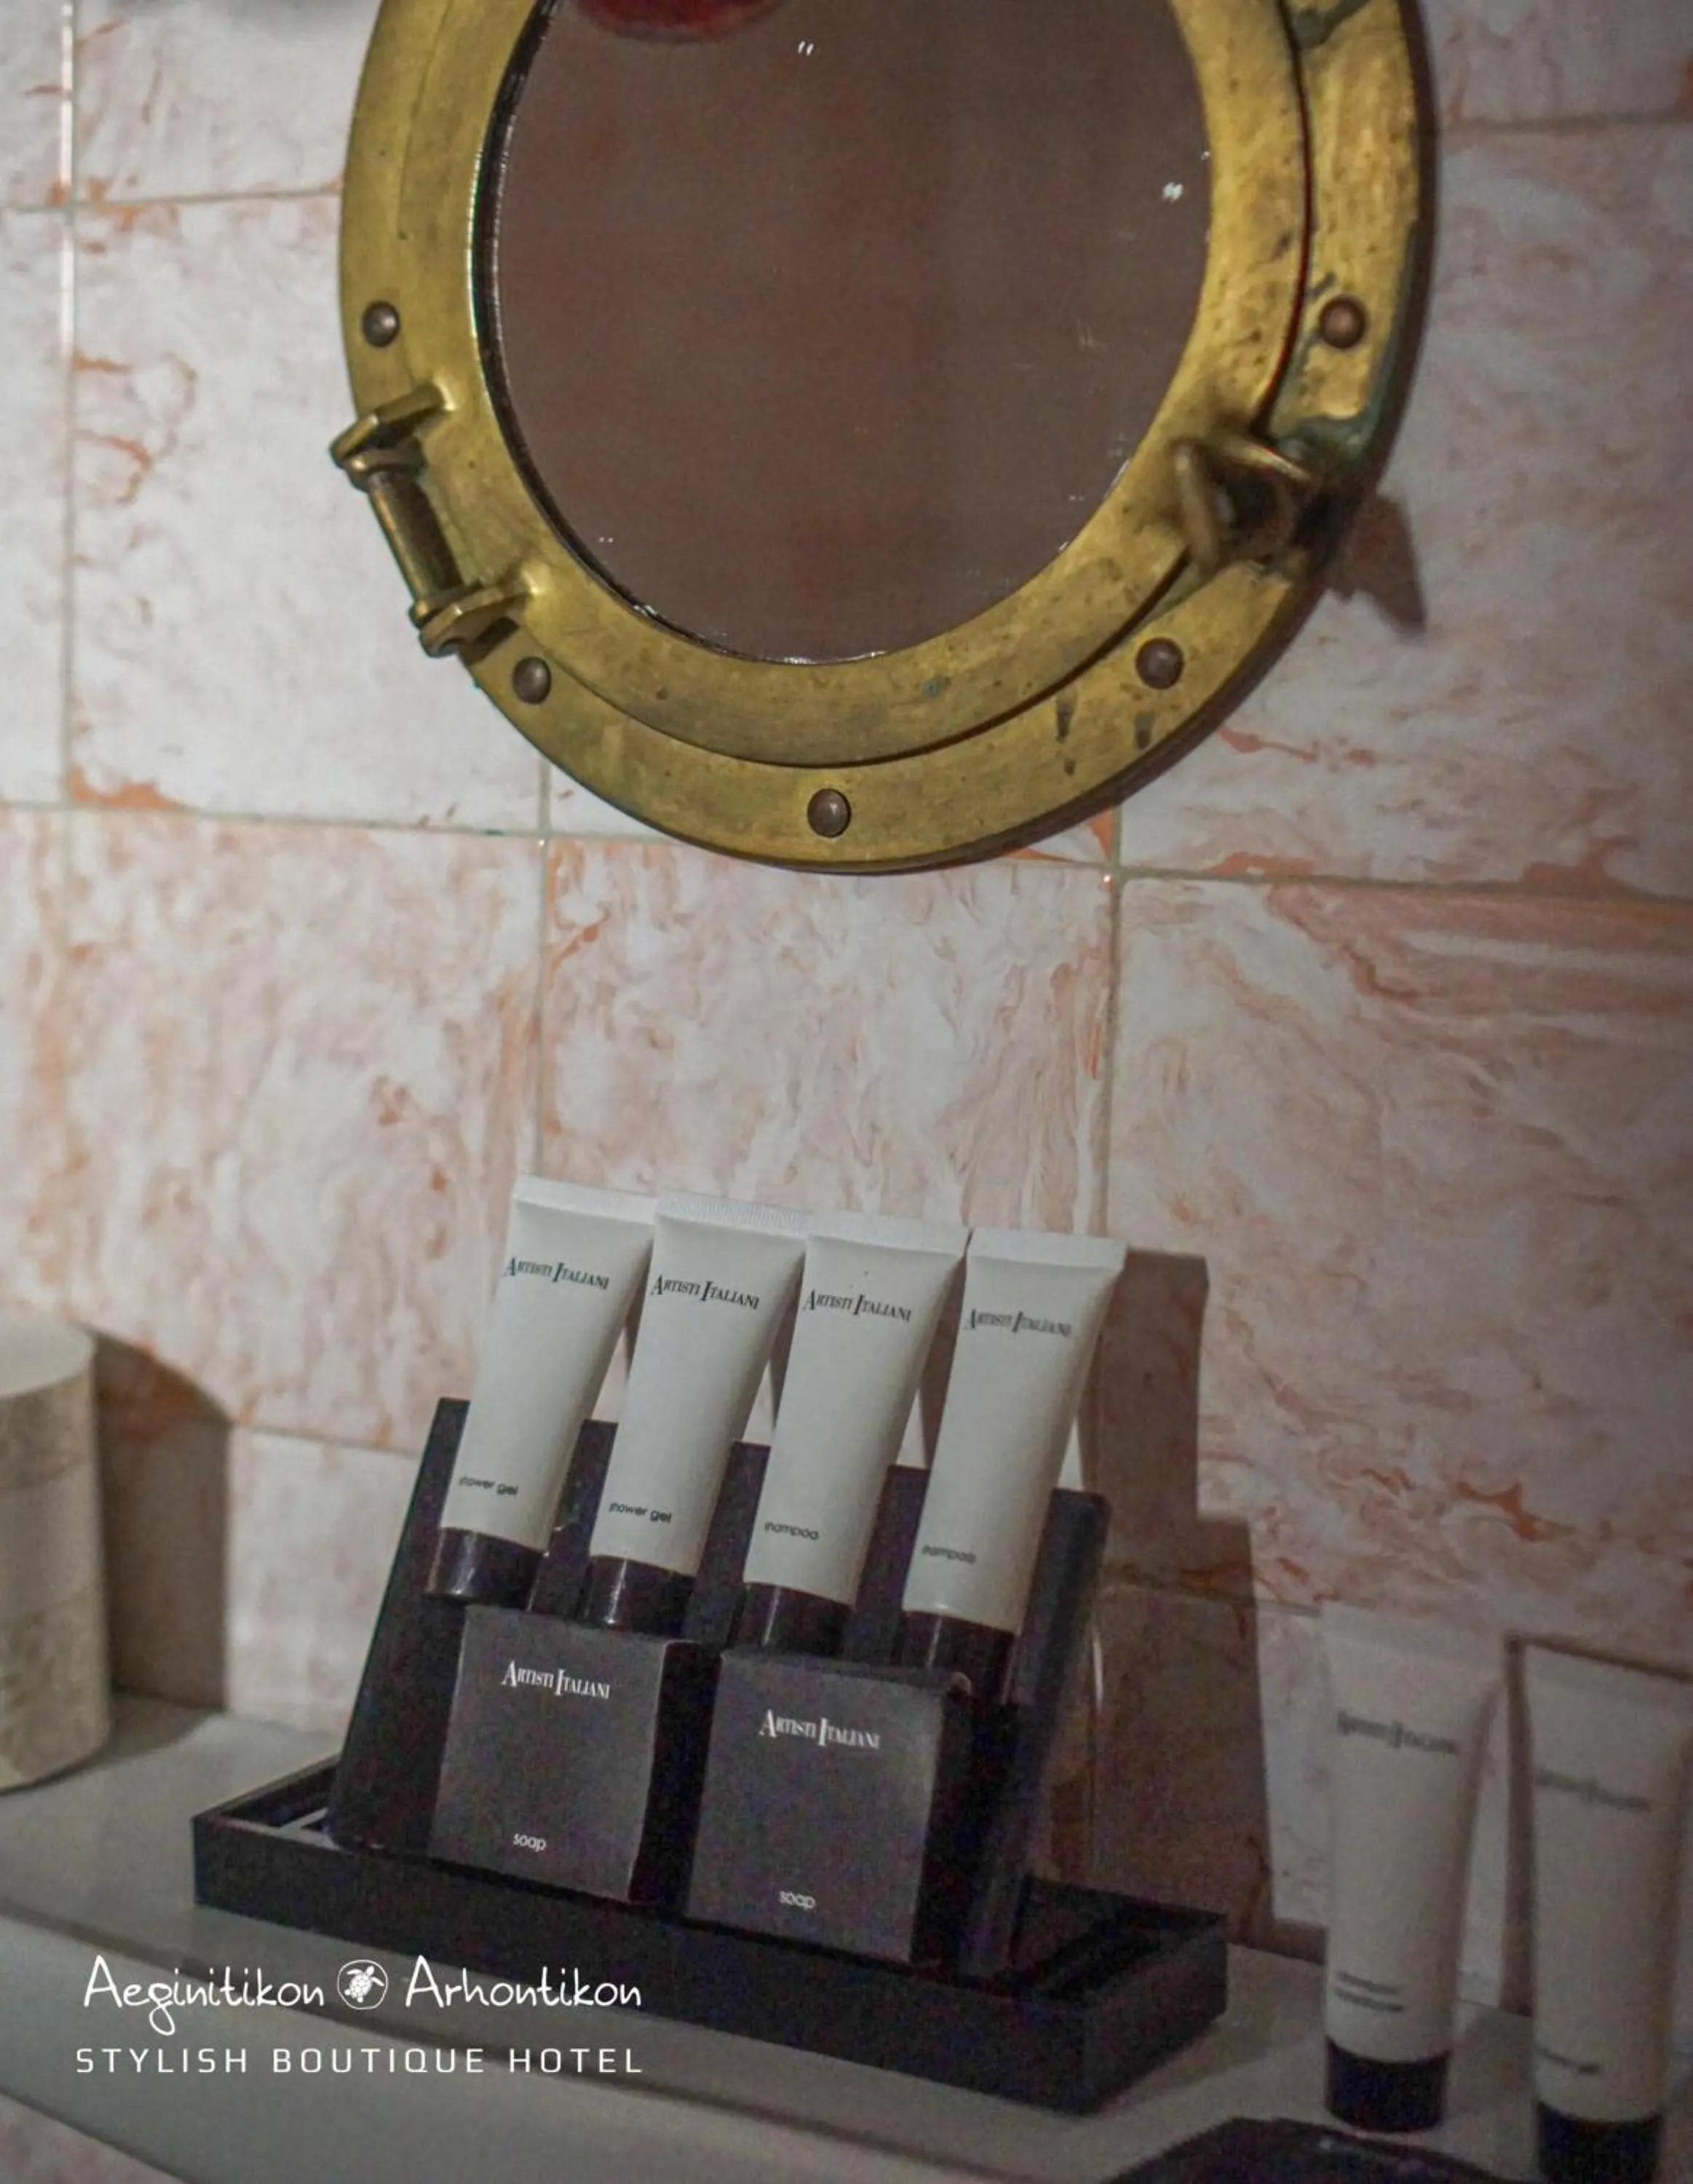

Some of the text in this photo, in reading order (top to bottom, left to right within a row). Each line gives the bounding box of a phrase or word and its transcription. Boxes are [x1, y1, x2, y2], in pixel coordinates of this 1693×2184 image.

[552, 1262, 610, 1290] ITALIANI
[650, 1274, 760, 1310] ARTISTI ITALIANI
[803, 1289, 912, 1322] ARTISTI ITALIANI
[650, 1510, 672, 1524] gel
[501, 1661, 611, 1699] ARTISTI ITALIANI
[758, 1709, 817, 1739] ARTISTI
[512, 1832, 547, 1852] soap
[779, 1891, 816, 1910] soap
